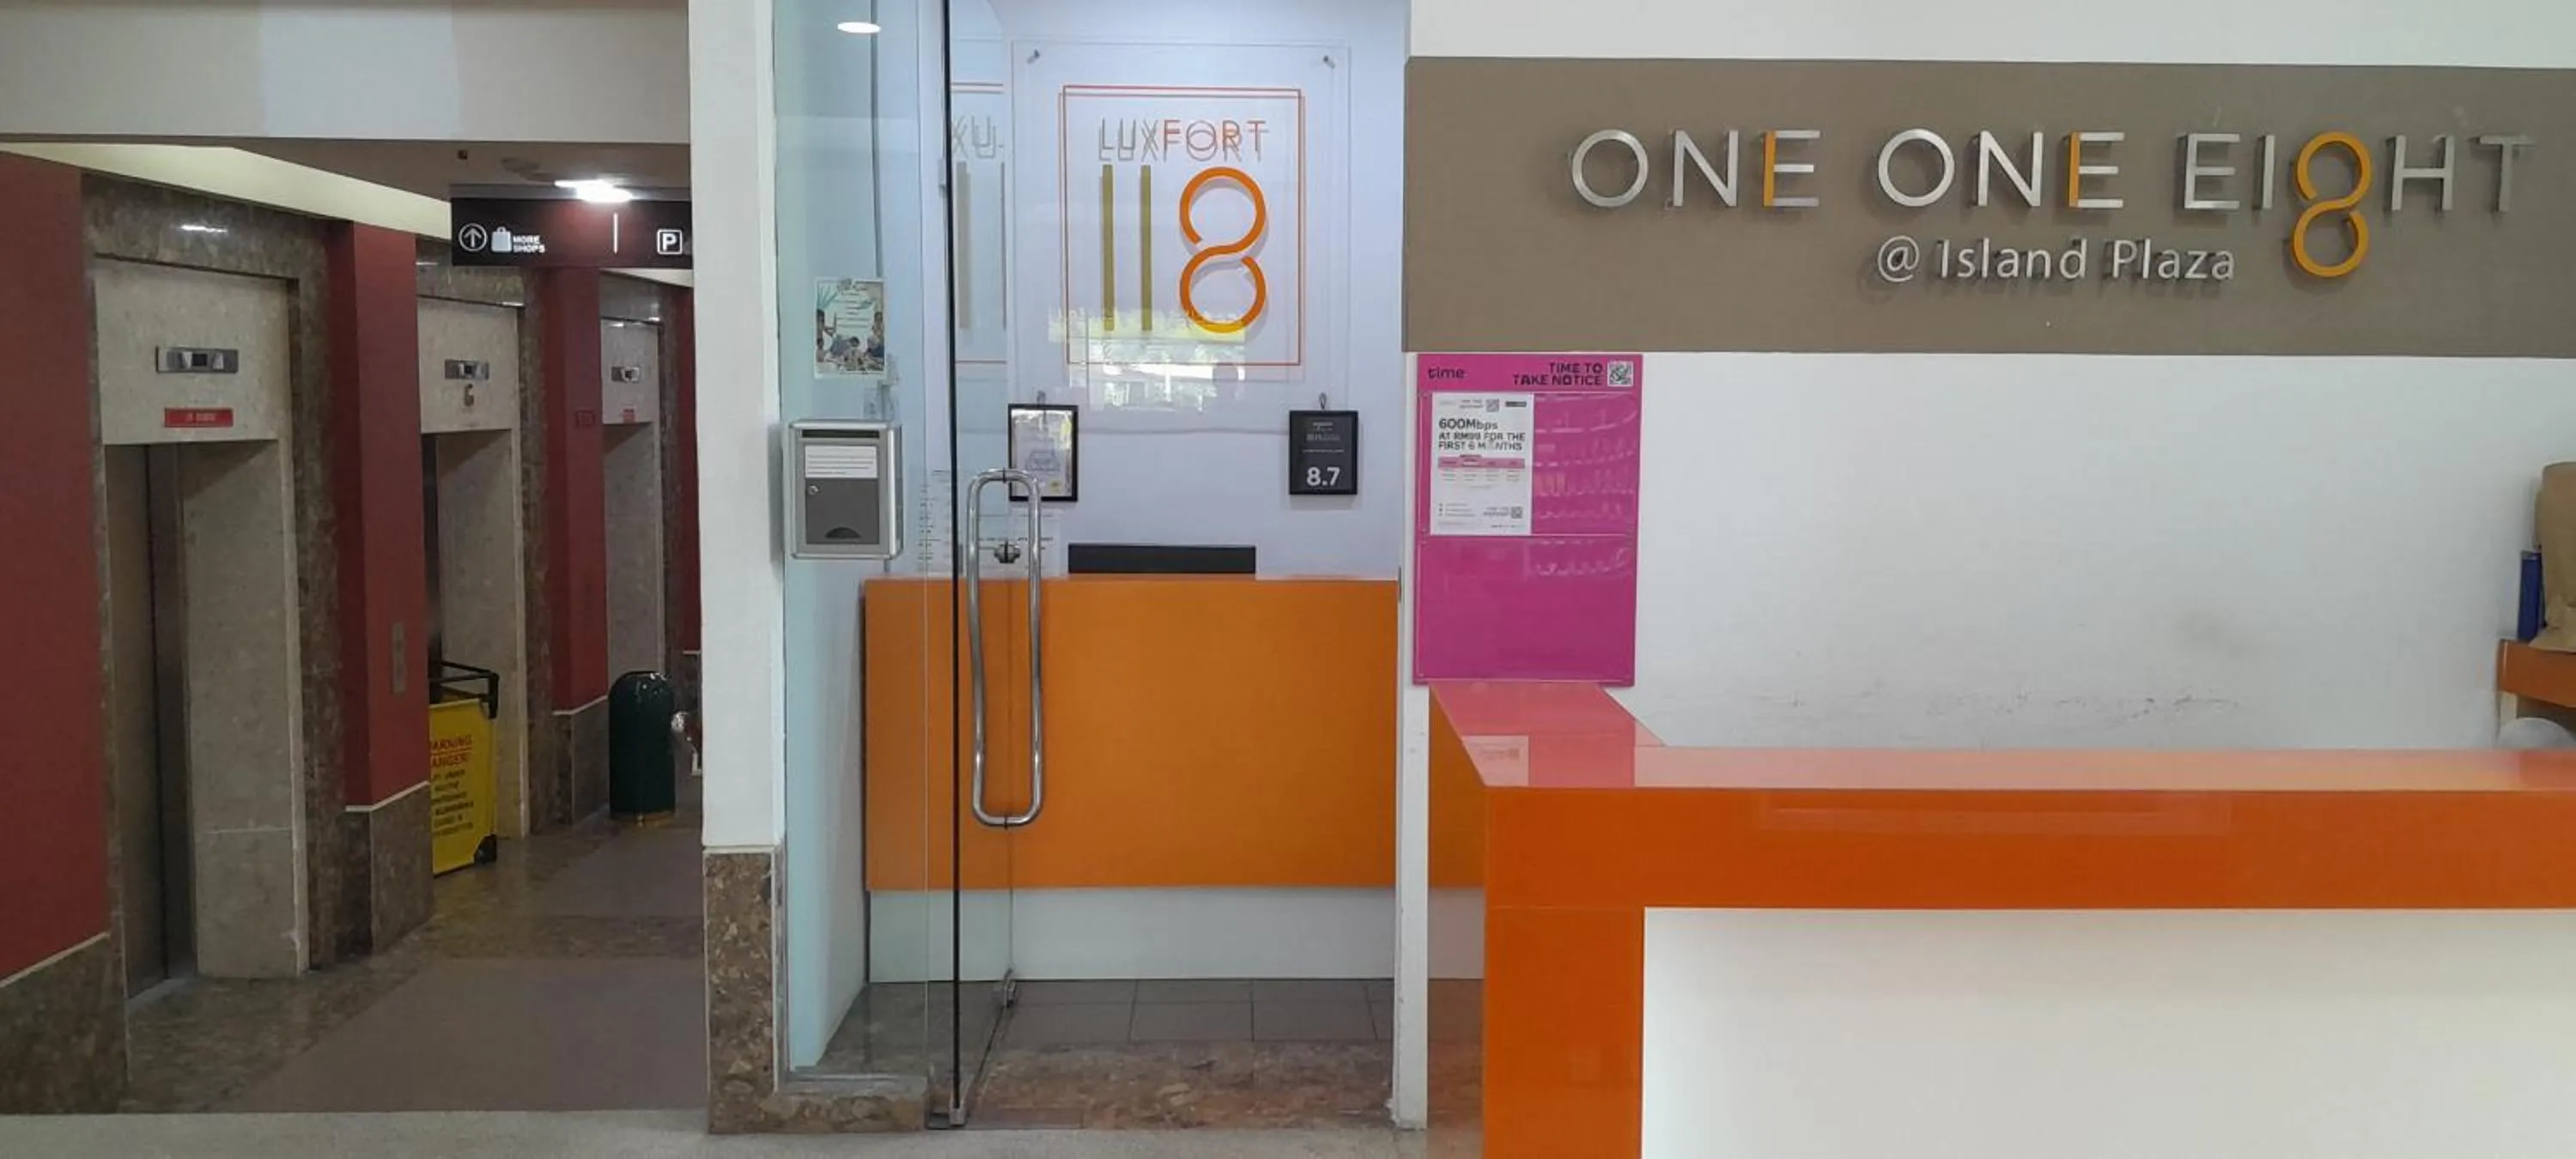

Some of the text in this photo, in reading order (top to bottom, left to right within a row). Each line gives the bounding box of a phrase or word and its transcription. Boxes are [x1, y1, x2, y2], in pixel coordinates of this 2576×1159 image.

[1100, 118, 1267, 155] LUXFORT
[1571, 129, 1820, 209] ONE
[1878, 128, 2124, 208] ONE
[513, 235, 541, 245] MORE
[661, 233, 677, 252] P
[513, 244, 546, 254] SHOPS
[1101, 164, 1267, 335] 118
[1877, 234, 2234, 282] @ Island Plaza
[1428, 367, 1466, 379] time
[1548, 362, 1603, 373] TIME TO
[1512, 374, 1603, 385] TAKE NOTICE
[1438, 418, 1498, 431] 600Mbps
[1485, 432, 1504, 440] FOR
[1507, 433, 1526, 442] THE
[1438, 441, 1466, 451] FIRST
[1479, 442, 1523, 452] MNTHS
[1307, 466, 1340, 487] 8.7
[430, 734, 472, 750] ARNING
